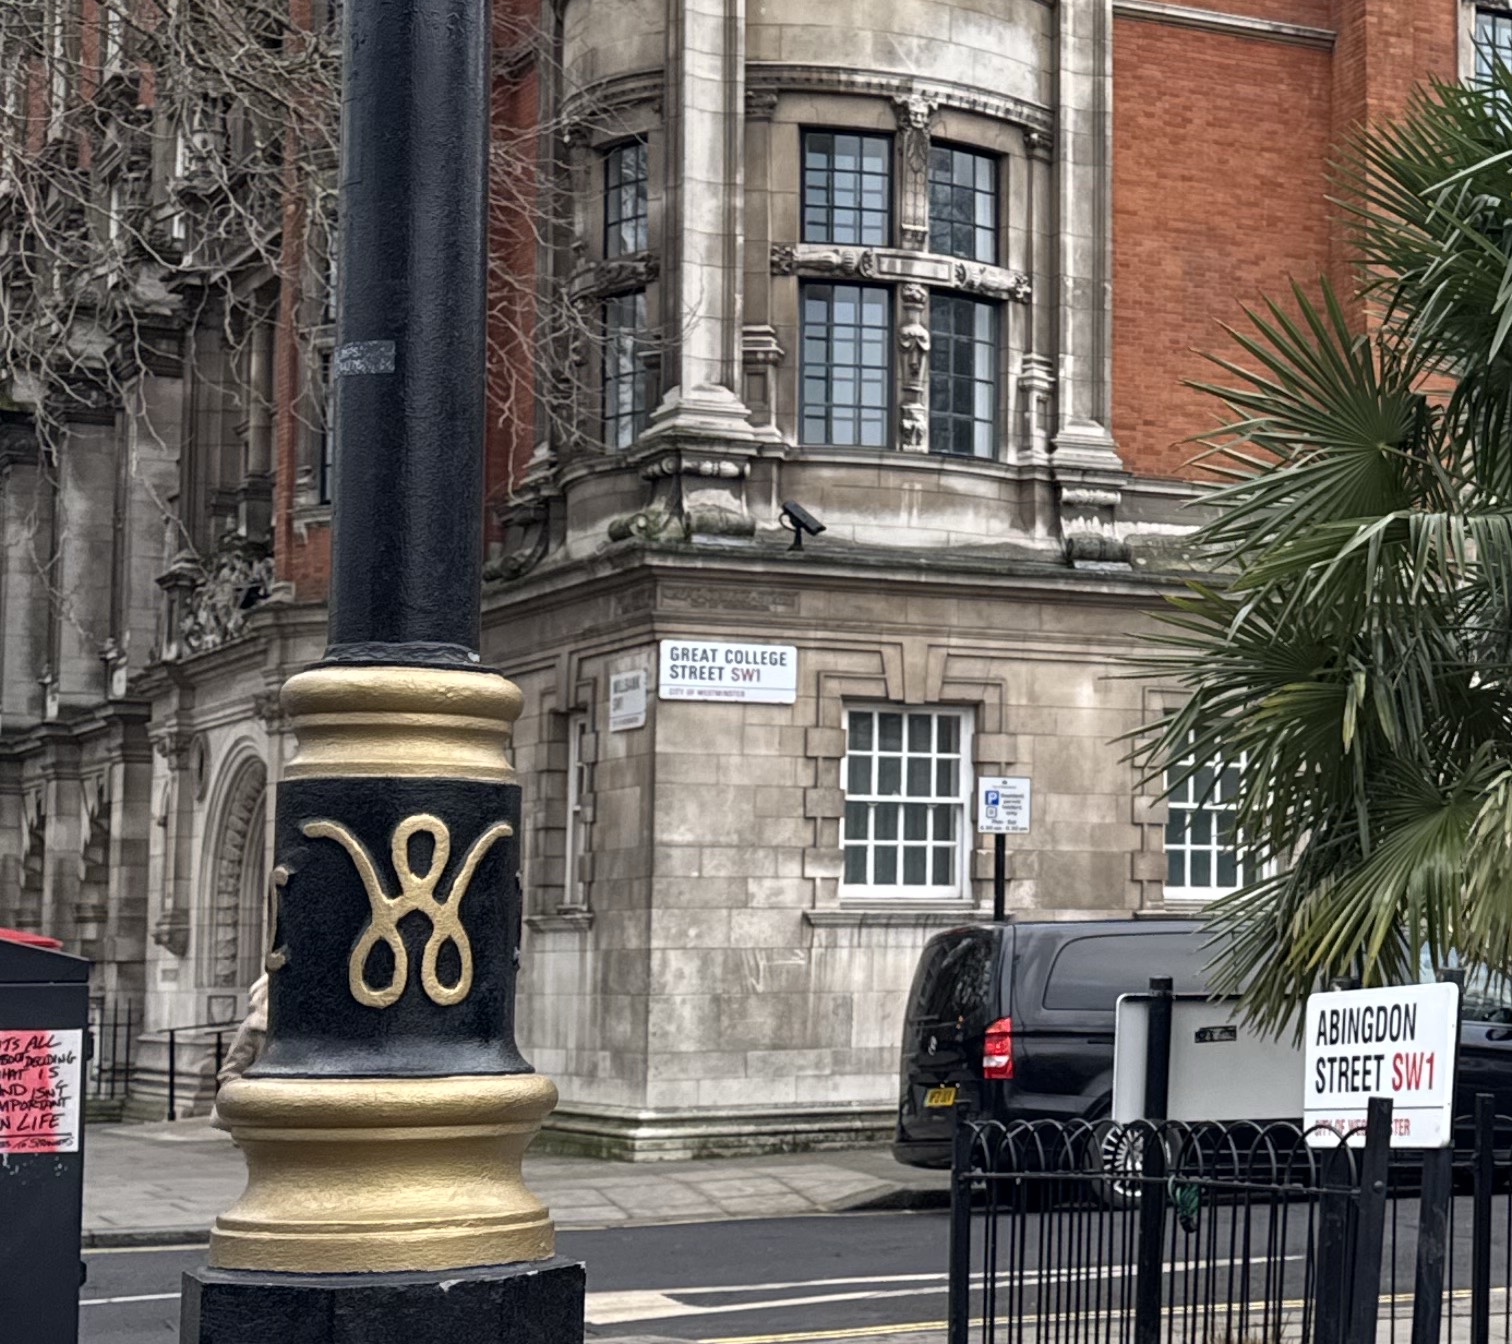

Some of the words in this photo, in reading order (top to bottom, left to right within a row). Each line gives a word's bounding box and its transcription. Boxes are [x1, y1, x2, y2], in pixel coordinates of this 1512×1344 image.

[670, 646, 718, 663] GREAT
[725, 649, 787, 666] COLLEGE
[669, 664, 725, 681] STREET
[731, 667, 761, 683] SW1
[1316, 1003, 1417, 1046] ABINGDON
[24, 1034, 61, 1052] ALL
[0, 1068, 29, 1081] HAT
[38, 1066, 60, 1080] IS
[1315, 1054, 1385, 1094] STREET
[1391, 1052, 1435, 1092] SW1
[0, 1083, 27, 1096] ND
[0, 1096, 72, 1112] MPORTANT
[17, 1112, 65, 1131] LIFE
